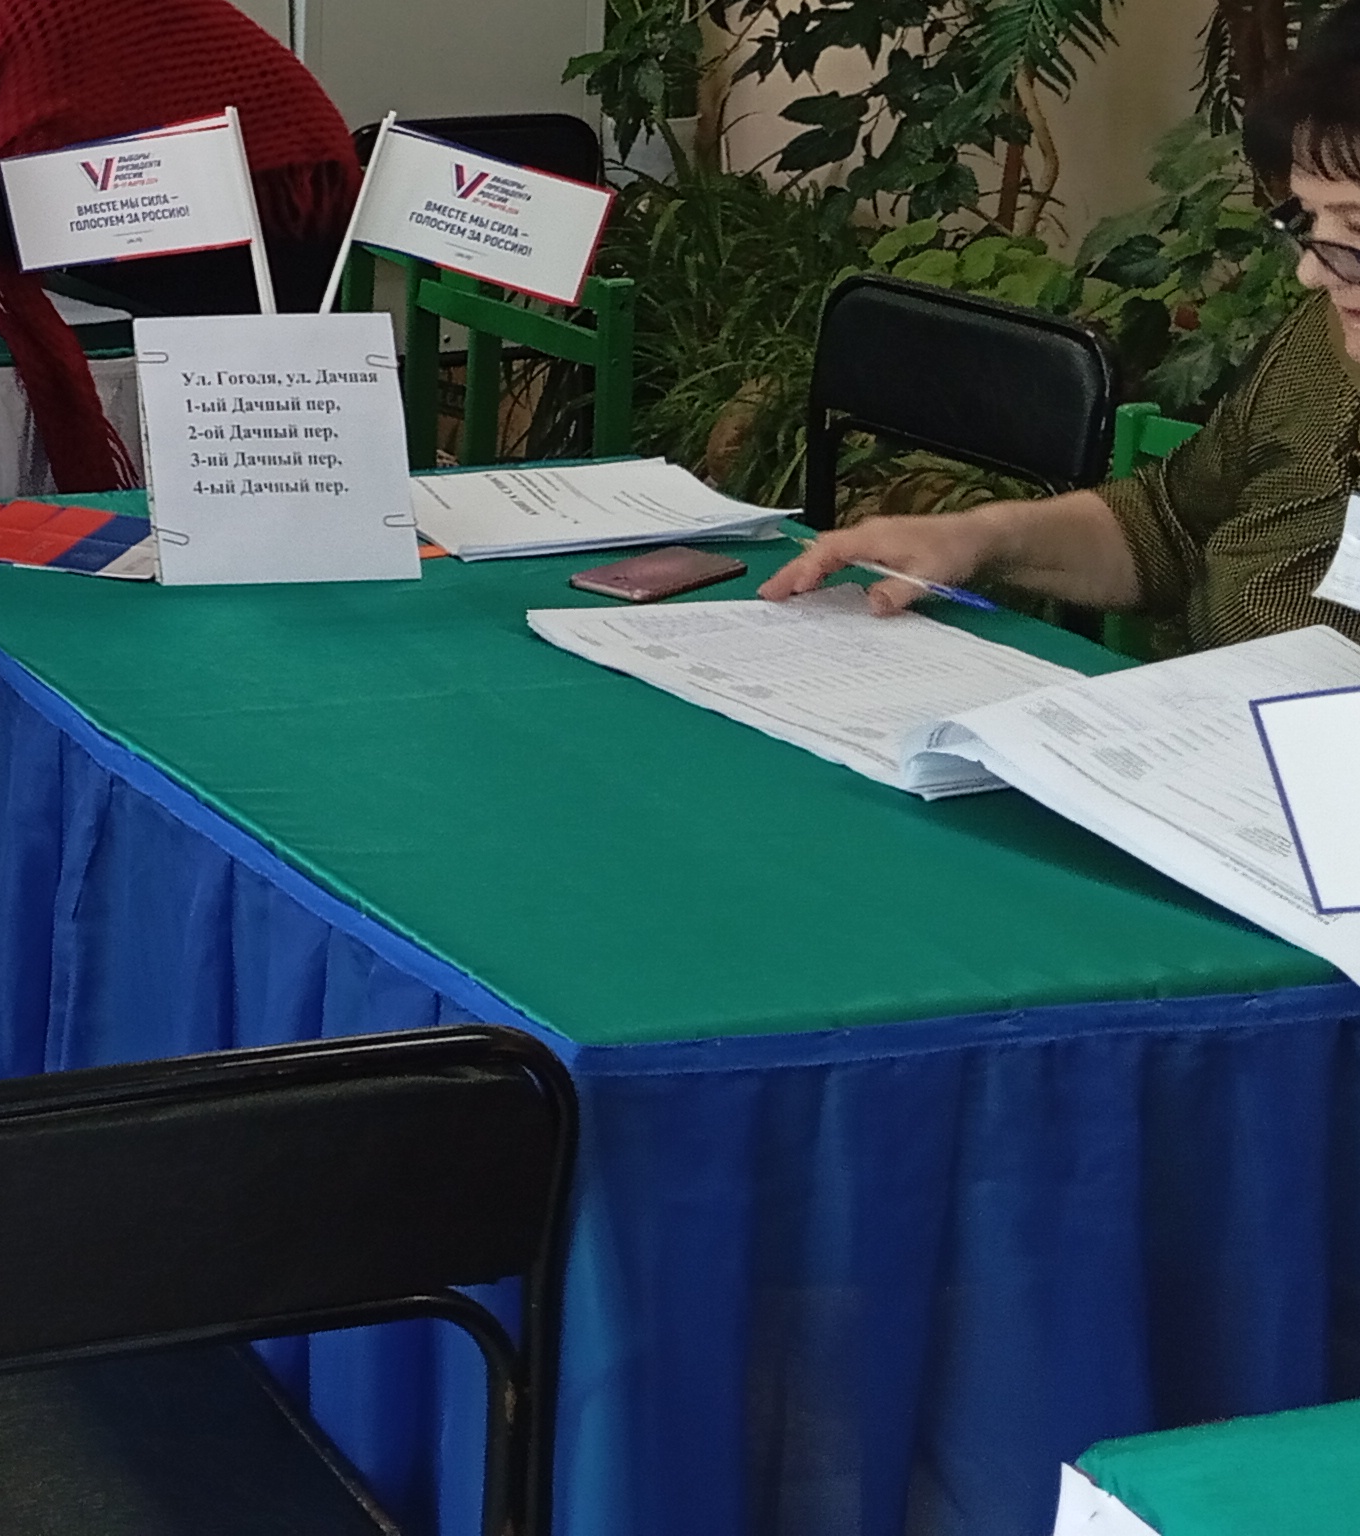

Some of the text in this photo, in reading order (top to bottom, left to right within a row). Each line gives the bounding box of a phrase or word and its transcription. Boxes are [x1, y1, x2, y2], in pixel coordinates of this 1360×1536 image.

[76, 200, 119, 217] ВМЕСТЕ
[120, 197, 139, 210] МЫ
[141, 193, 170, 208] СИЛА
[69, 205, 190, 232] ГОЛОСУЕМ ЗА РОССИЮ!
[424, 200, 468, 223] ВМЕСТЕ
[469, 214, 489, 229] МЫ
[490, 221, 519, 237] СИЛА
[408, 211, 467, 238] ГОЛОСУЕМ
[467, 229, 481, 242] ЗА
[483, 234, 533, 257] РОССИЮ!
[181, 369, 378, 387] Ул. Гоголя, ул. Дачная
[185, 397, 227, 413] 1-ый
[232, 396, 301, 414] Дачный
[188, 424, 225, 440] 2-ой
[229, 424, 298, 441] Дачный
[190, 452, 229, 468] 3-ий
[233, 450, 303, 468] Дачный
[192, 479, 235, 495] 4-ый
[240, 478, 310, 496] Дачный
